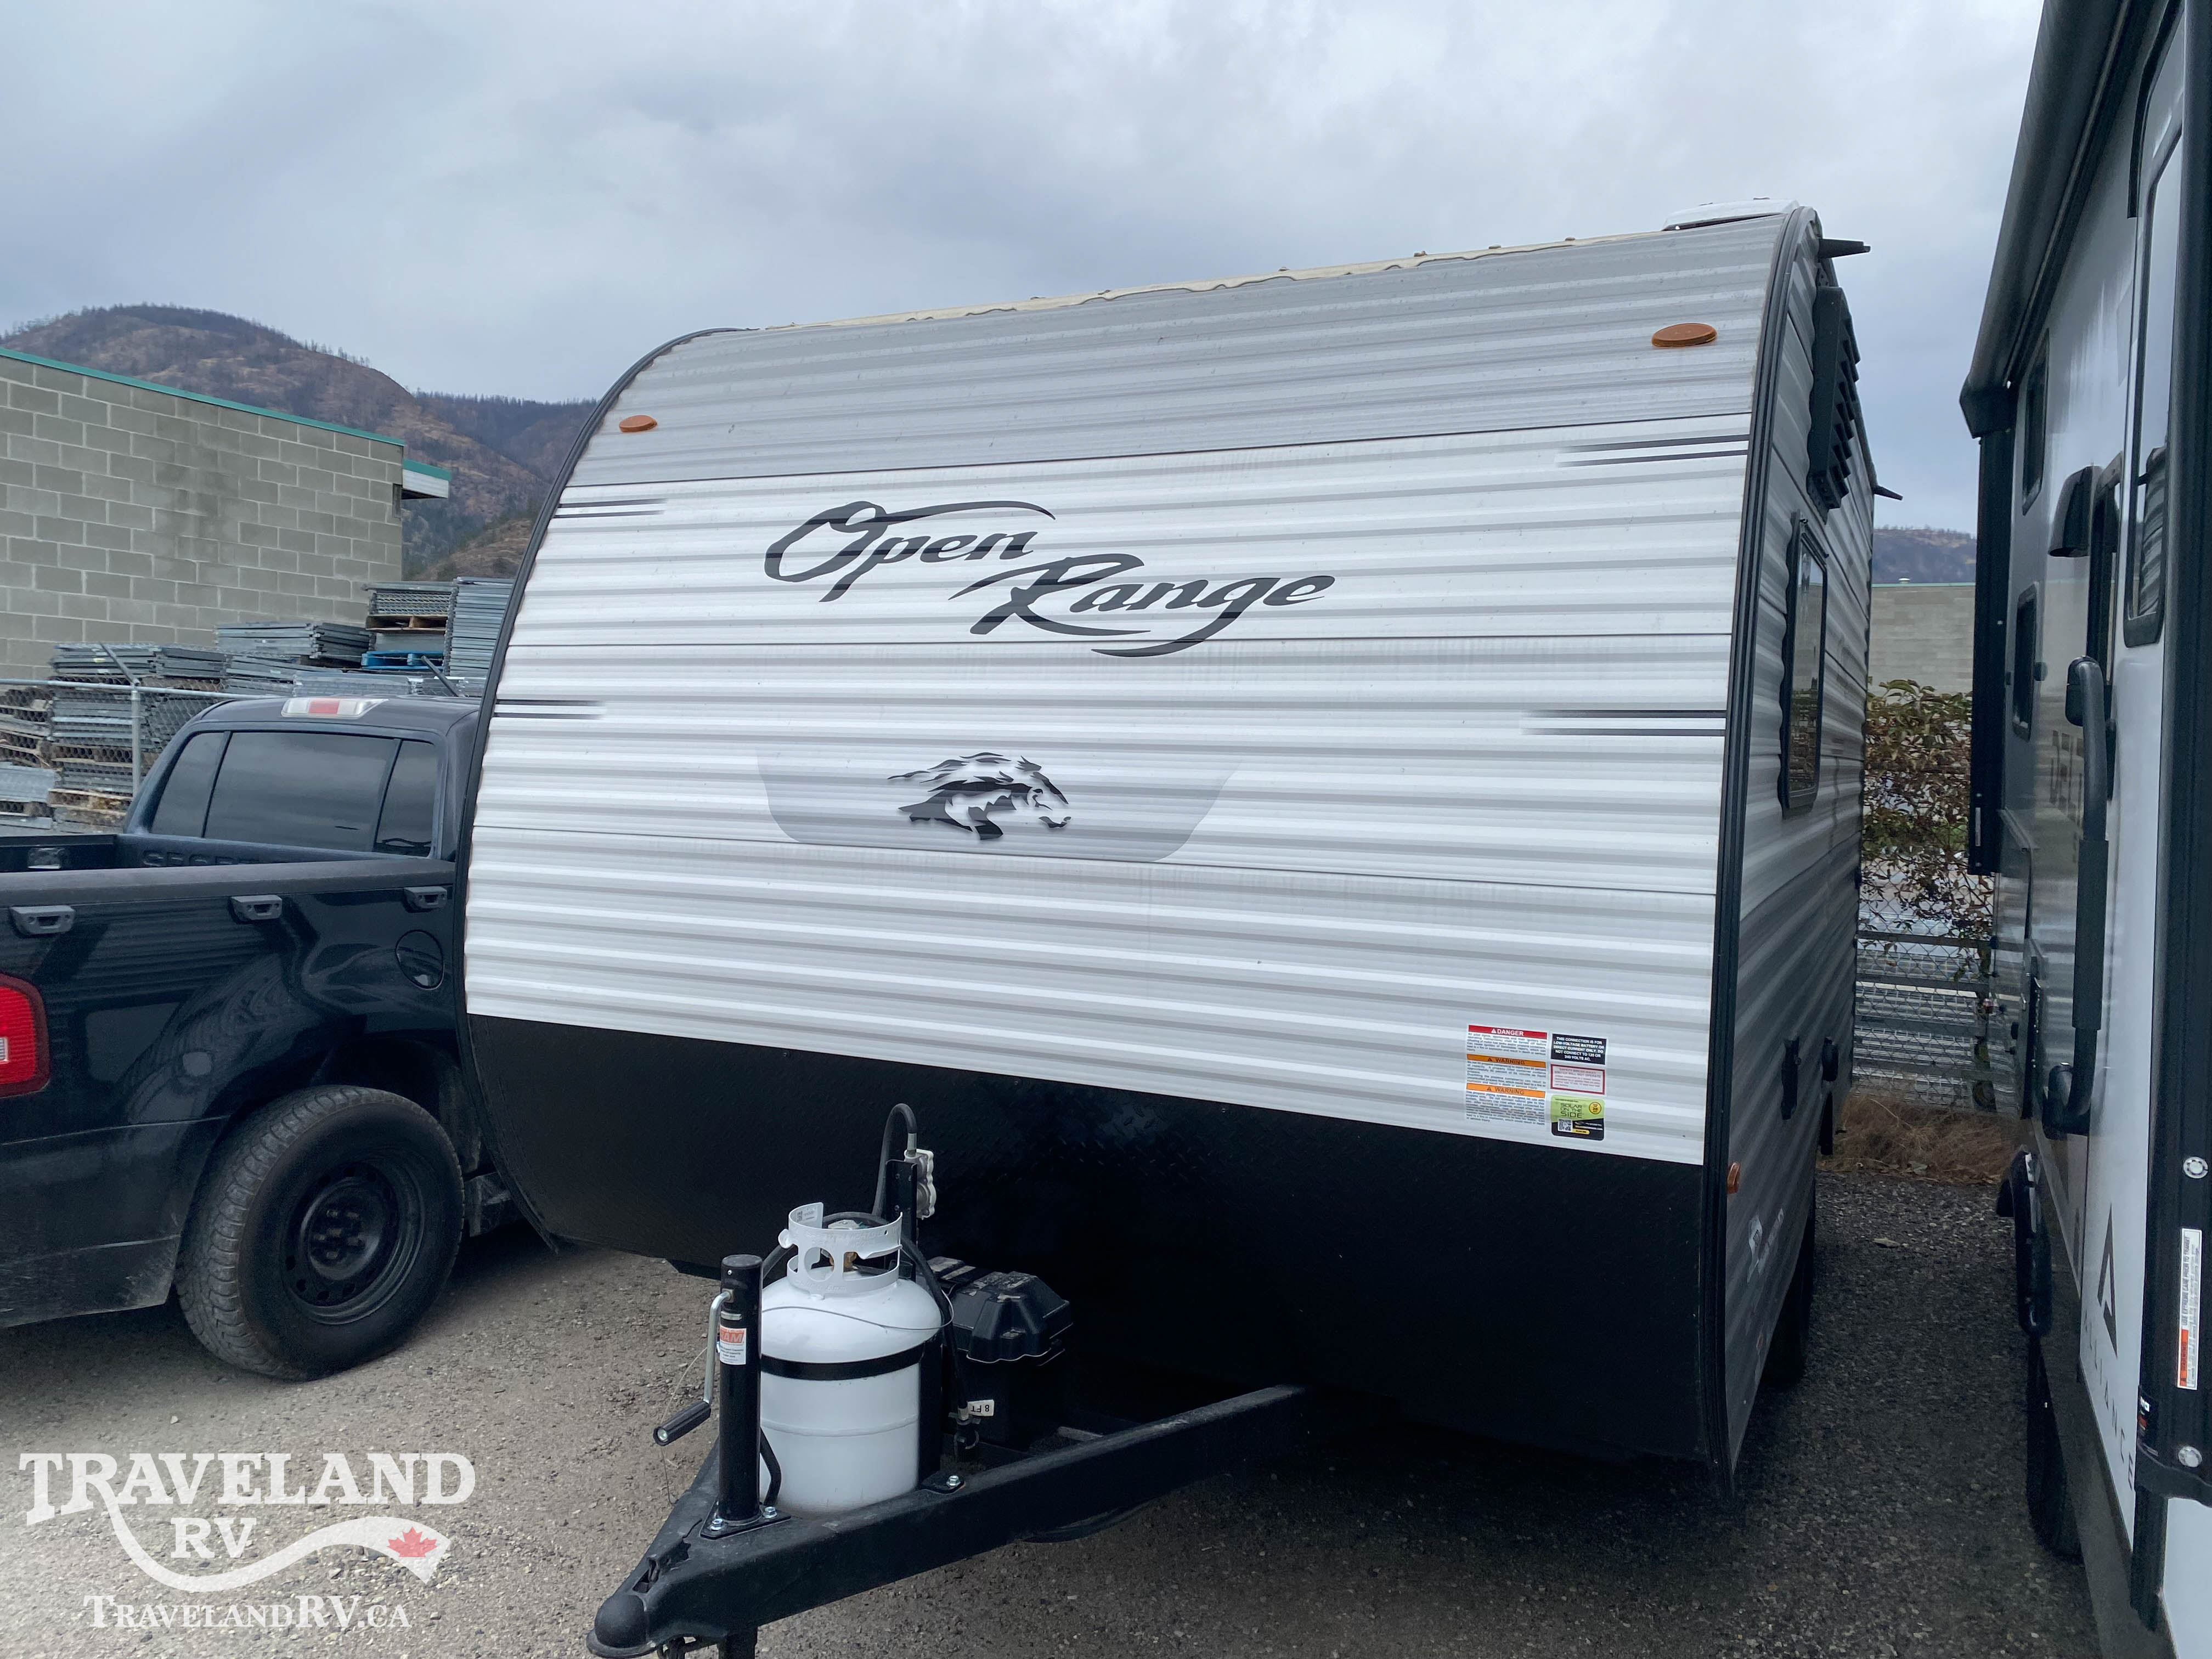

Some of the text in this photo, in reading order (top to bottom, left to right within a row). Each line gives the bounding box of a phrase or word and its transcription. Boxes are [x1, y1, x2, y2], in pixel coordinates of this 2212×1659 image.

[764, 500, 1056, 602] Open
[947, 553, 1336, 658] Range
[2084, 1308, 2134, 1492] ALLIANCE
